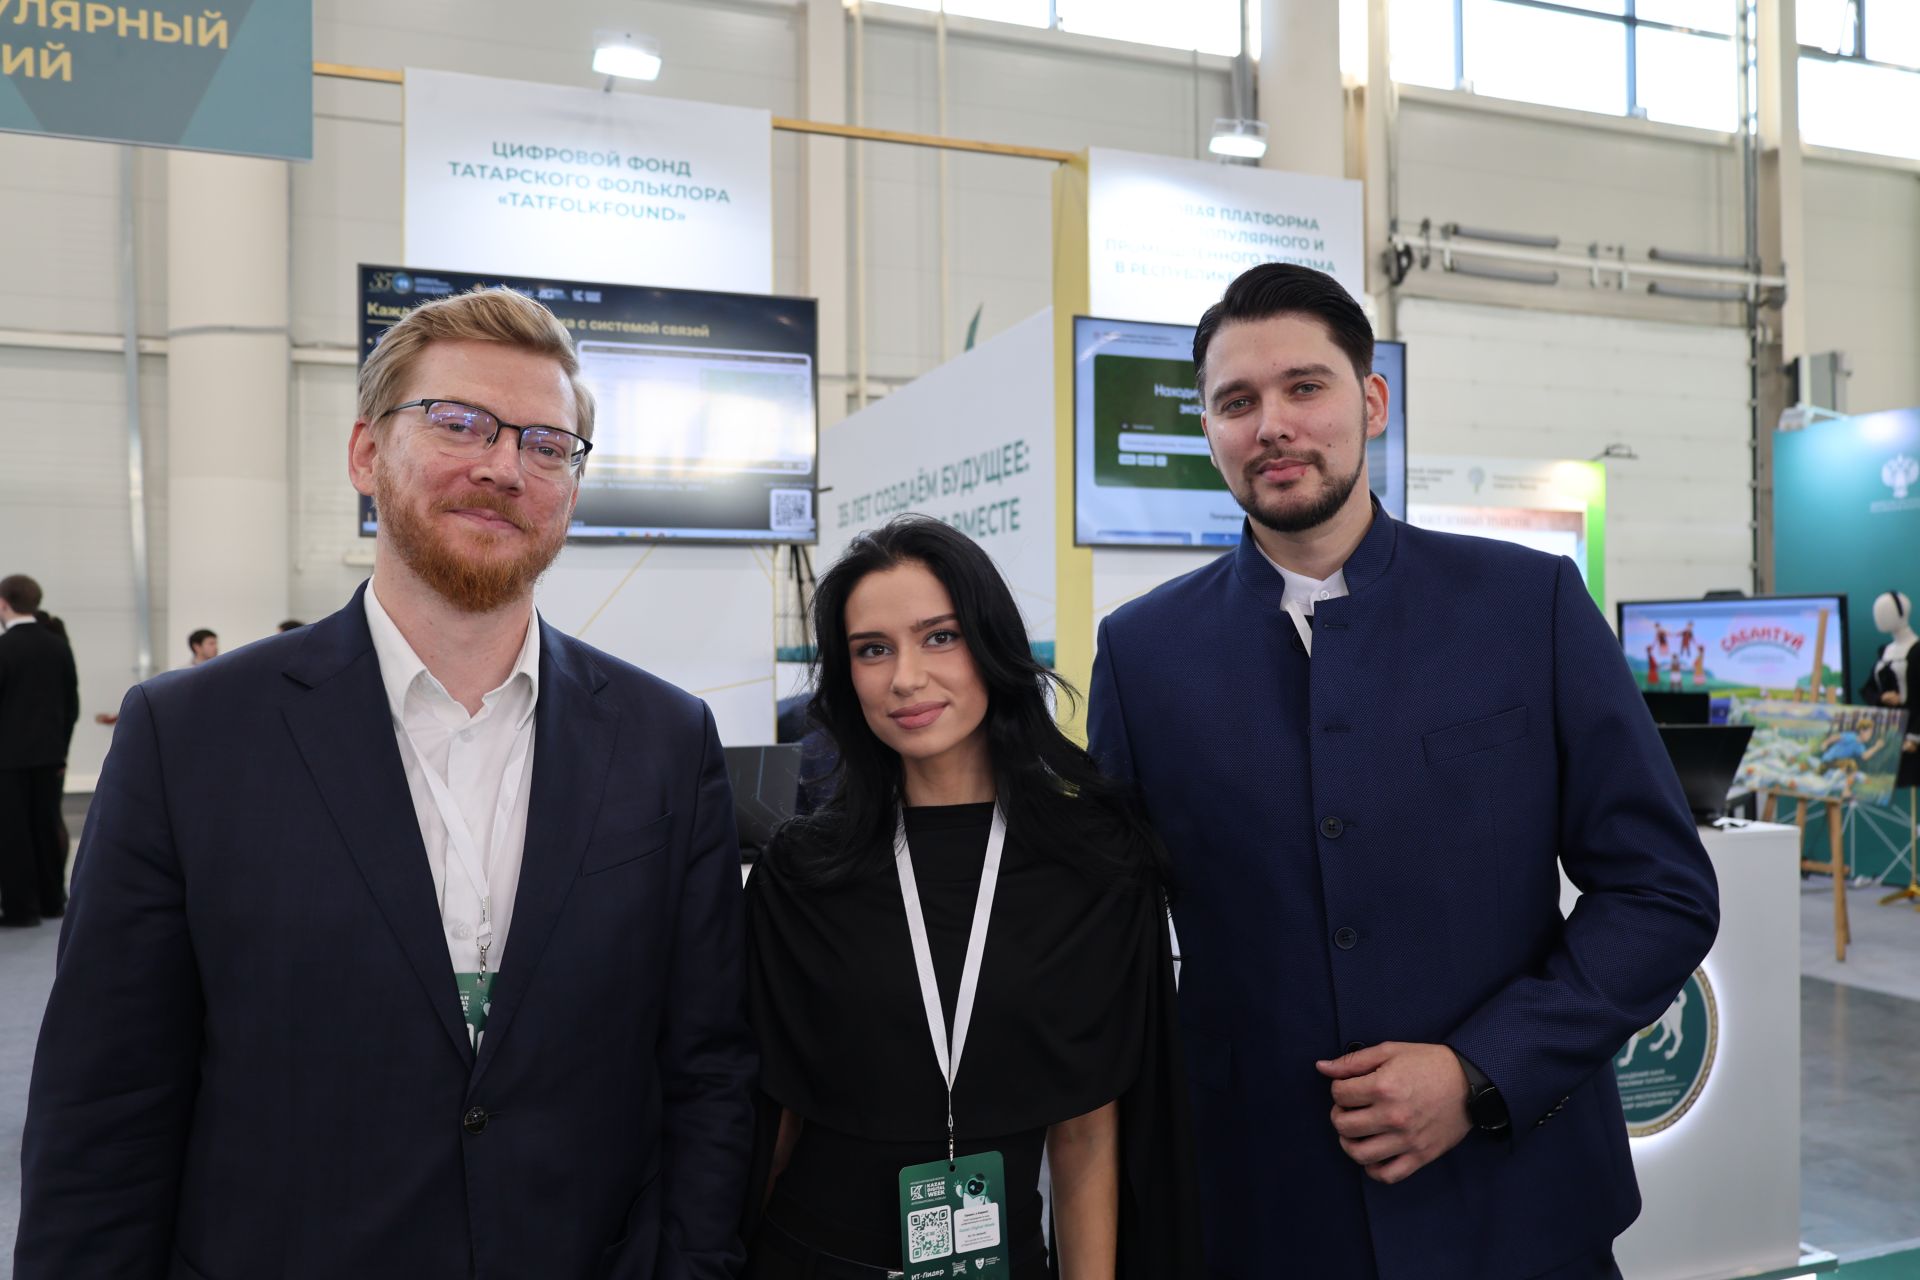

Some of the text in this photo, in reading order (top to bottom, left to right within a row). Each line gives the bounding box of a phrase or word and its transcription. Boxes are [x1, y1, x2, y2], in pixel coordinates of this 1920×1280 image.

[492, 141, 692, 179] ЦИФРОВОЙ ФОНД
[448, 161, 731, 205] ТАТАРСКОГО ФОЛЬКЛОРА
[1220, 206, 1321, 231] ПЛАТФОРМА
[1313, 238, 1325, 253] И
[589, 319, 660, 335] системой
[661, 323, 711, 338] связей
[851, 493, 871, 523] ЛЕТ
[875, 468, 938, 517] СОЗДАЁМ
[942, 439, 1030, 497] БУДУЩЕЕ:
